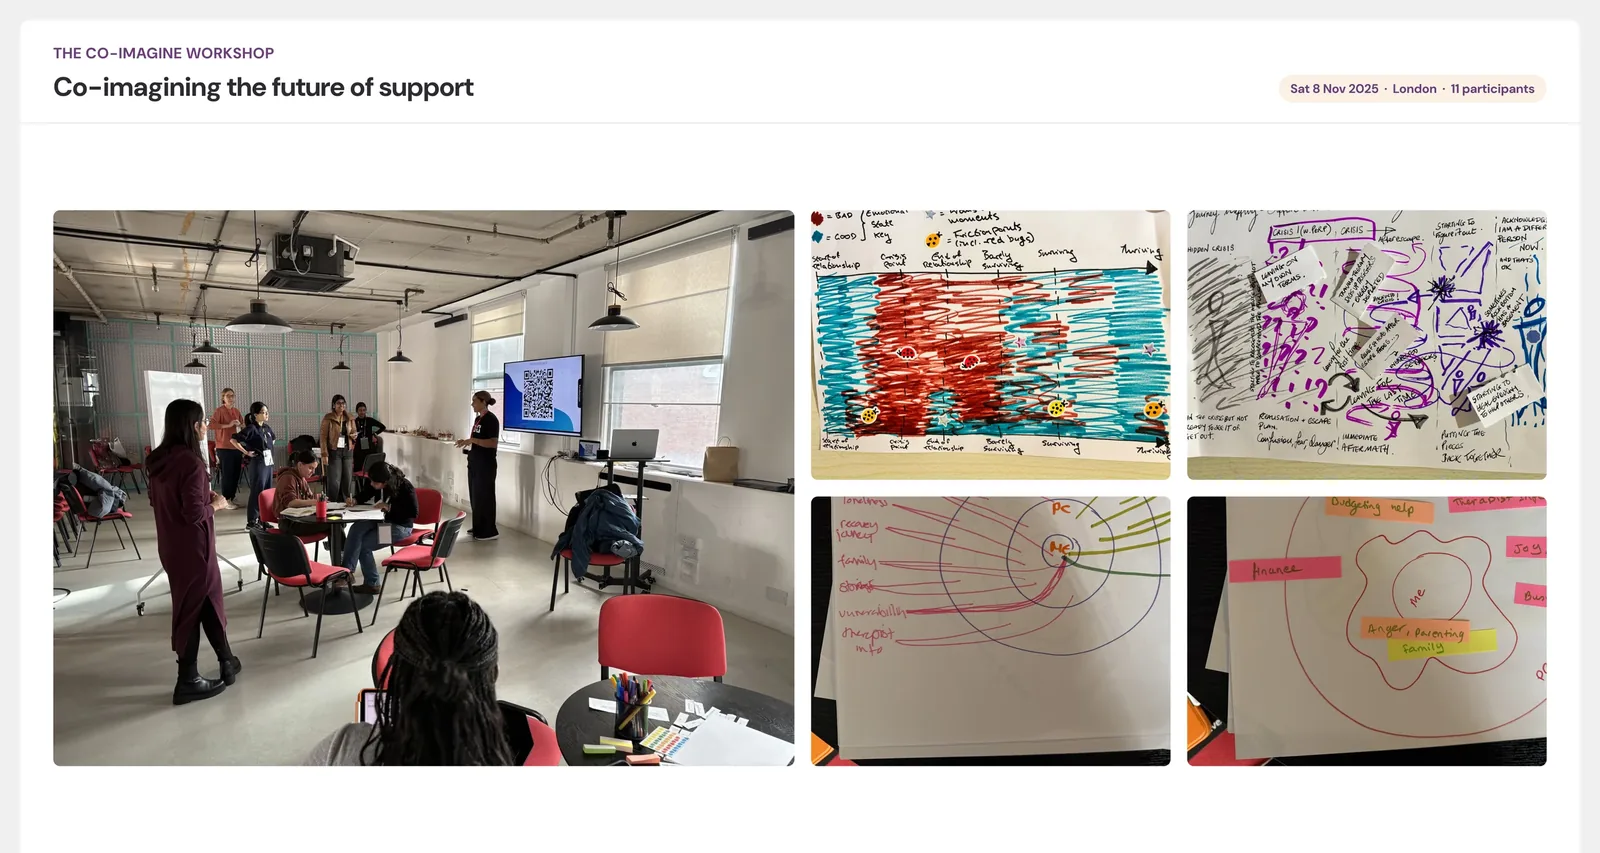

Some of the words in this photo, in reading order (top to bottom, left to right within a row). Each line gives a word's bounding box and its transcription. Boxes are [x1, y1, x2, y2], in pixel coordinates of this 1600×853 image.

[1272, 228, 1293, 237] CRISIS
[1341, 225, 1364, 234] CRISIS
[1006, 232, 1035, 247] bugs)
[1497, 233, 1527, 243] PERSON
[1212, 244, 1235, 252] CRISIS
[1285, 256, 1298, 266] ON
[1261, 277, 1275, 288] MY
[1275, 270, 1292, 283] OWN
[1391, 502, 1414, 517] help
[838, 554, 877, 571] family
